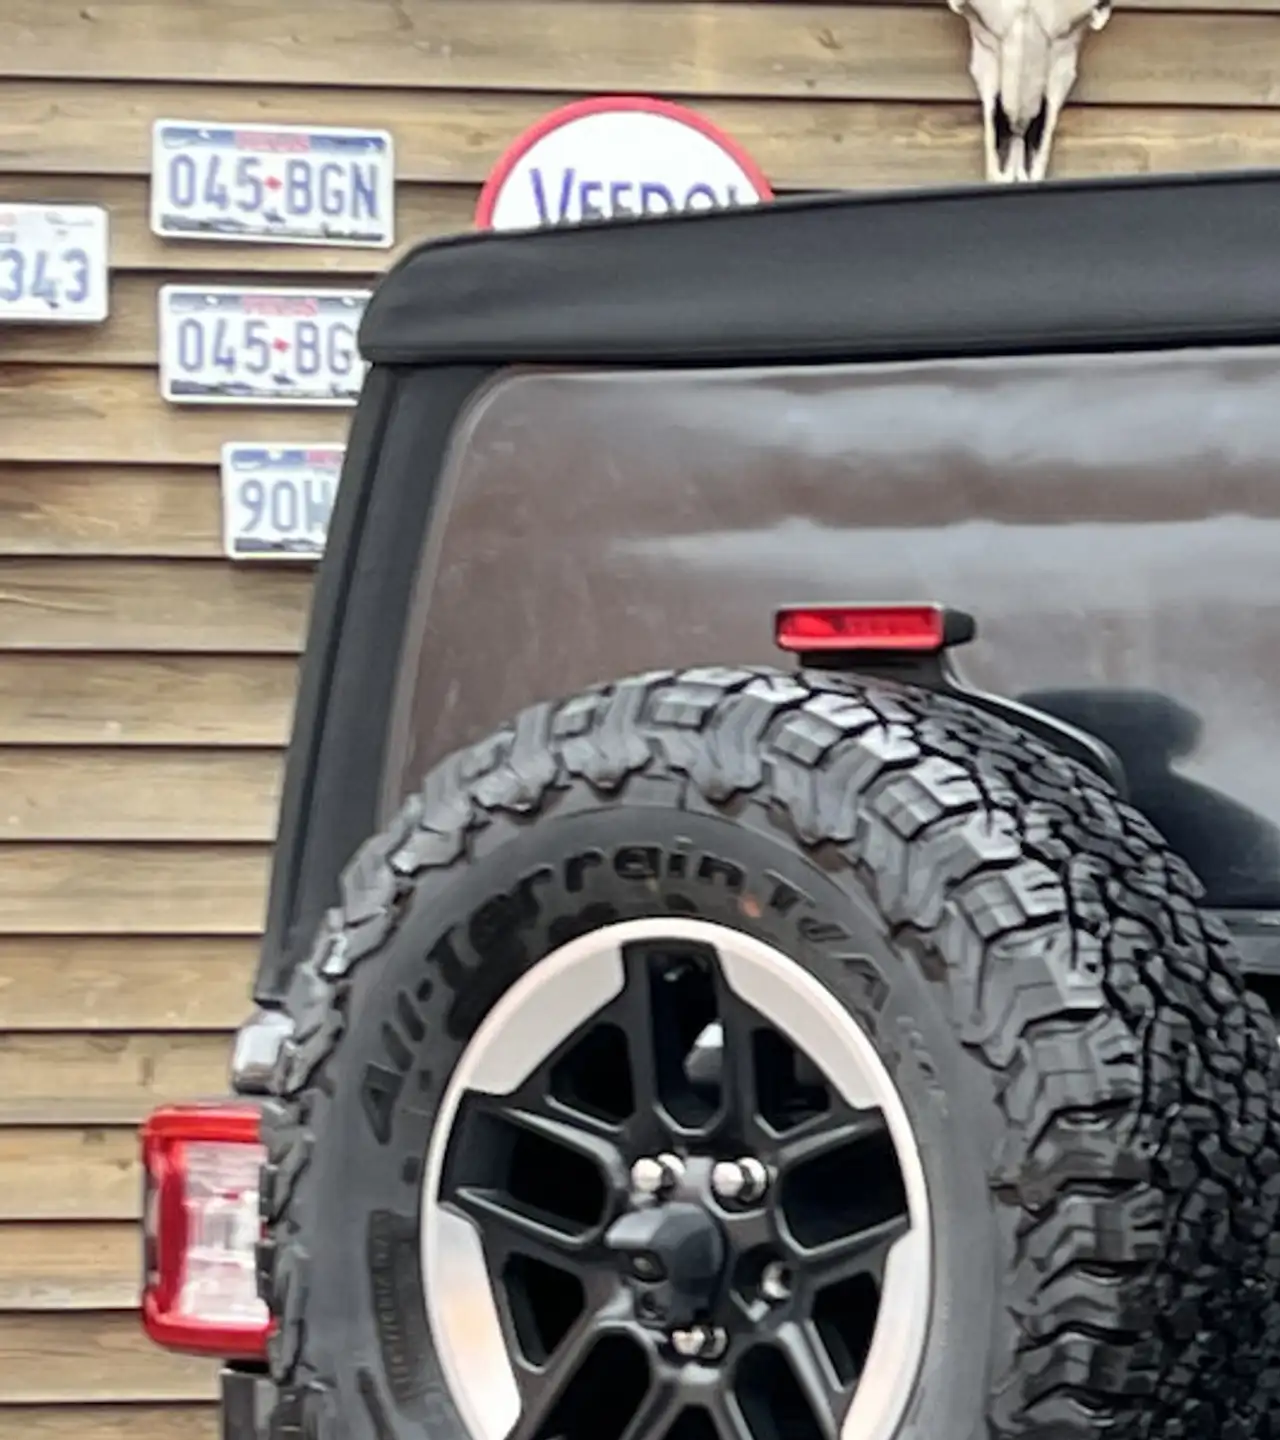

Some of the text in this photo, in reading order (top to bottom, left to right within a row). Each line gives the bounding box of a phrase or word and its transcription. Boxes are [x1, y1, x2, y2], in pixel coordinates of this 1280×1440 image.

[169, 153, 378, 218] 045 BGN
[0, 248, 89, 303] 343
[178, 318, 270, 373] 045
